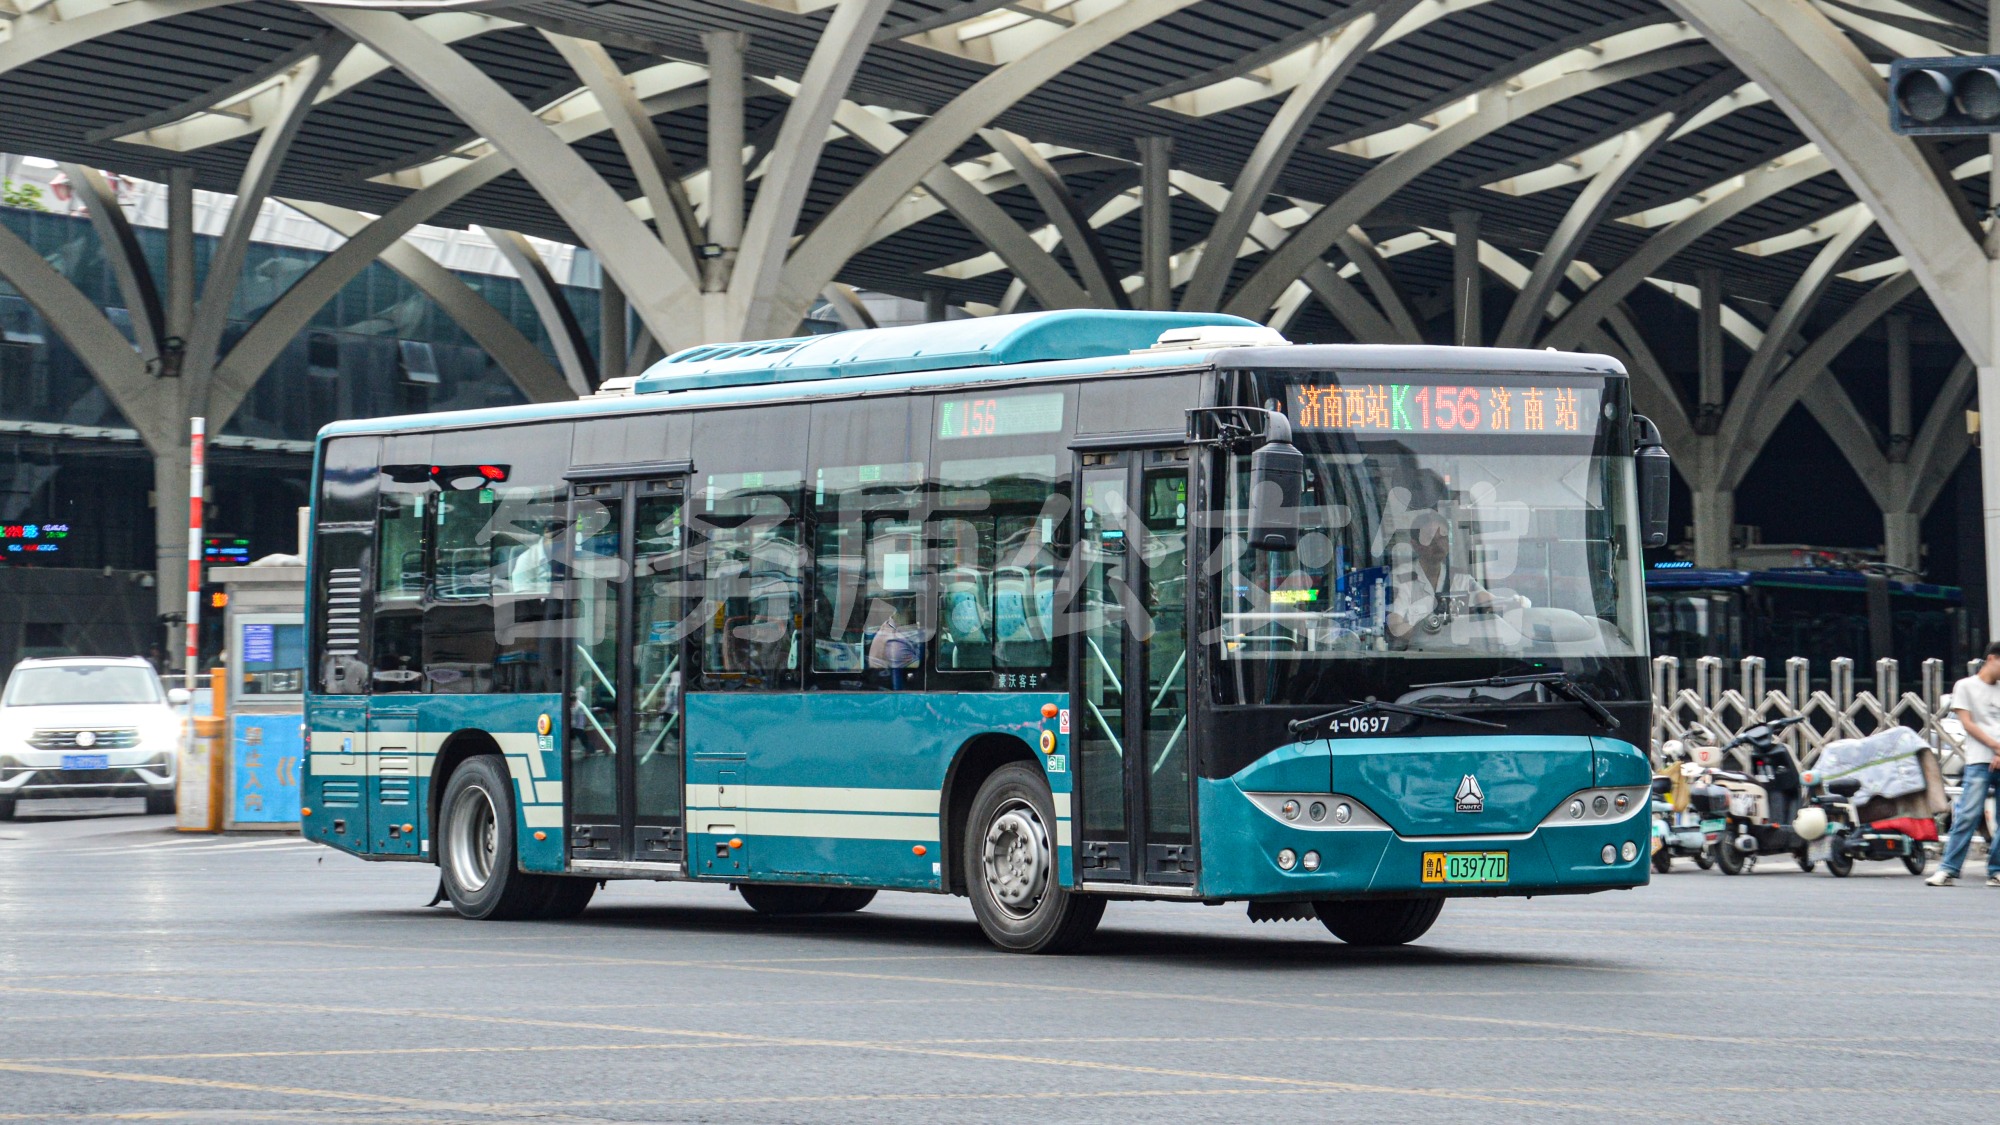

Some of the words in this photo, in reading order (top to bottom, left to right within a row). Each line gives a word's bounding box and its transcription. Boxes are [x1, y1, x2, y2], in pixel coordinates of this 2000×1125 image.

[1298, 384, 1389, 428] 济南西站
[998, 673, 1037, 688] 豪沃客车
[1329, 716, 1389, 732] 4-0697
